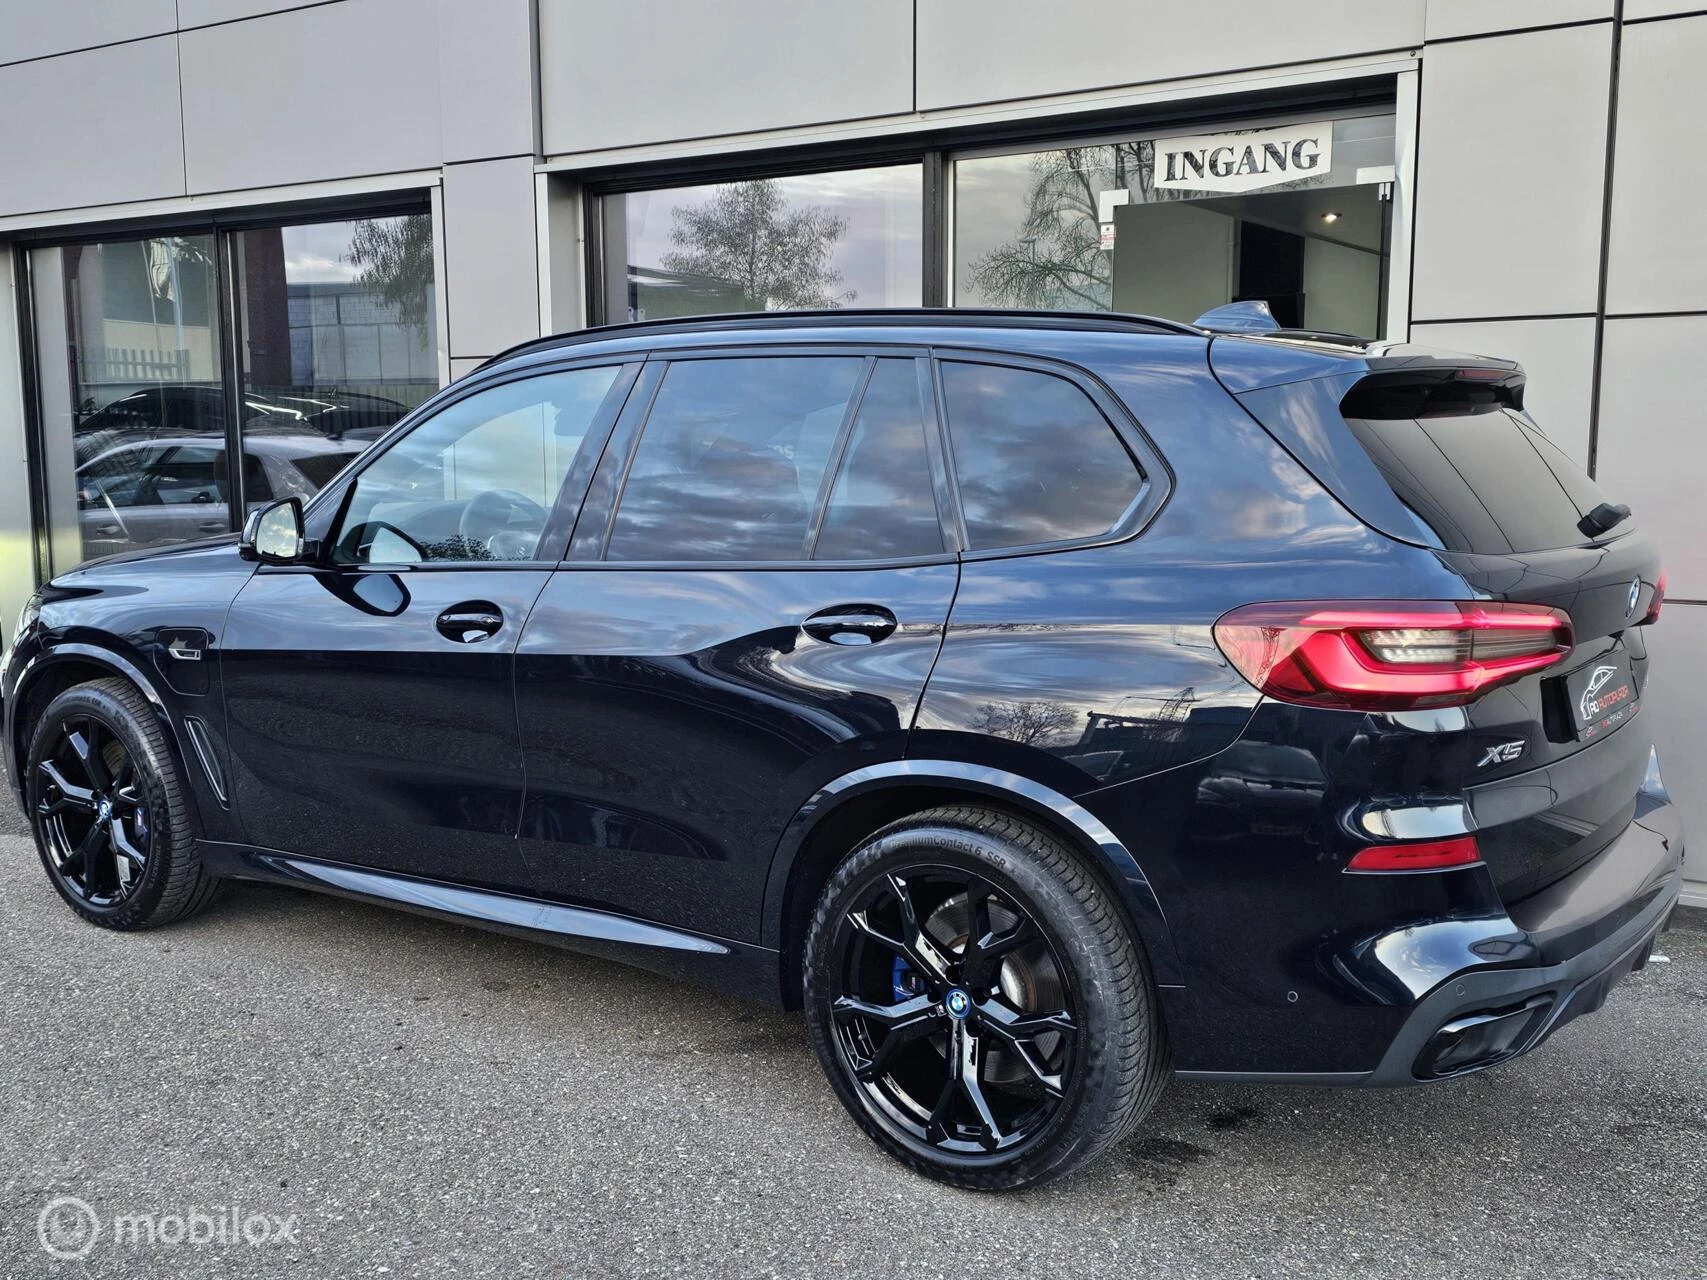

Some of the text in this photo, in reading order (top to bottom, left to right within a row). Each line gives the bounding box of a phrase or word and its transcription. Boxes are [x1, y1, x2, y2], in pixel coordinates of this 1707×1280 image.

[1164, 138, 1321, 181] INGANG
[1477, 740, 1525, 767] X5
[985, 851, 1006, 870] SSR
